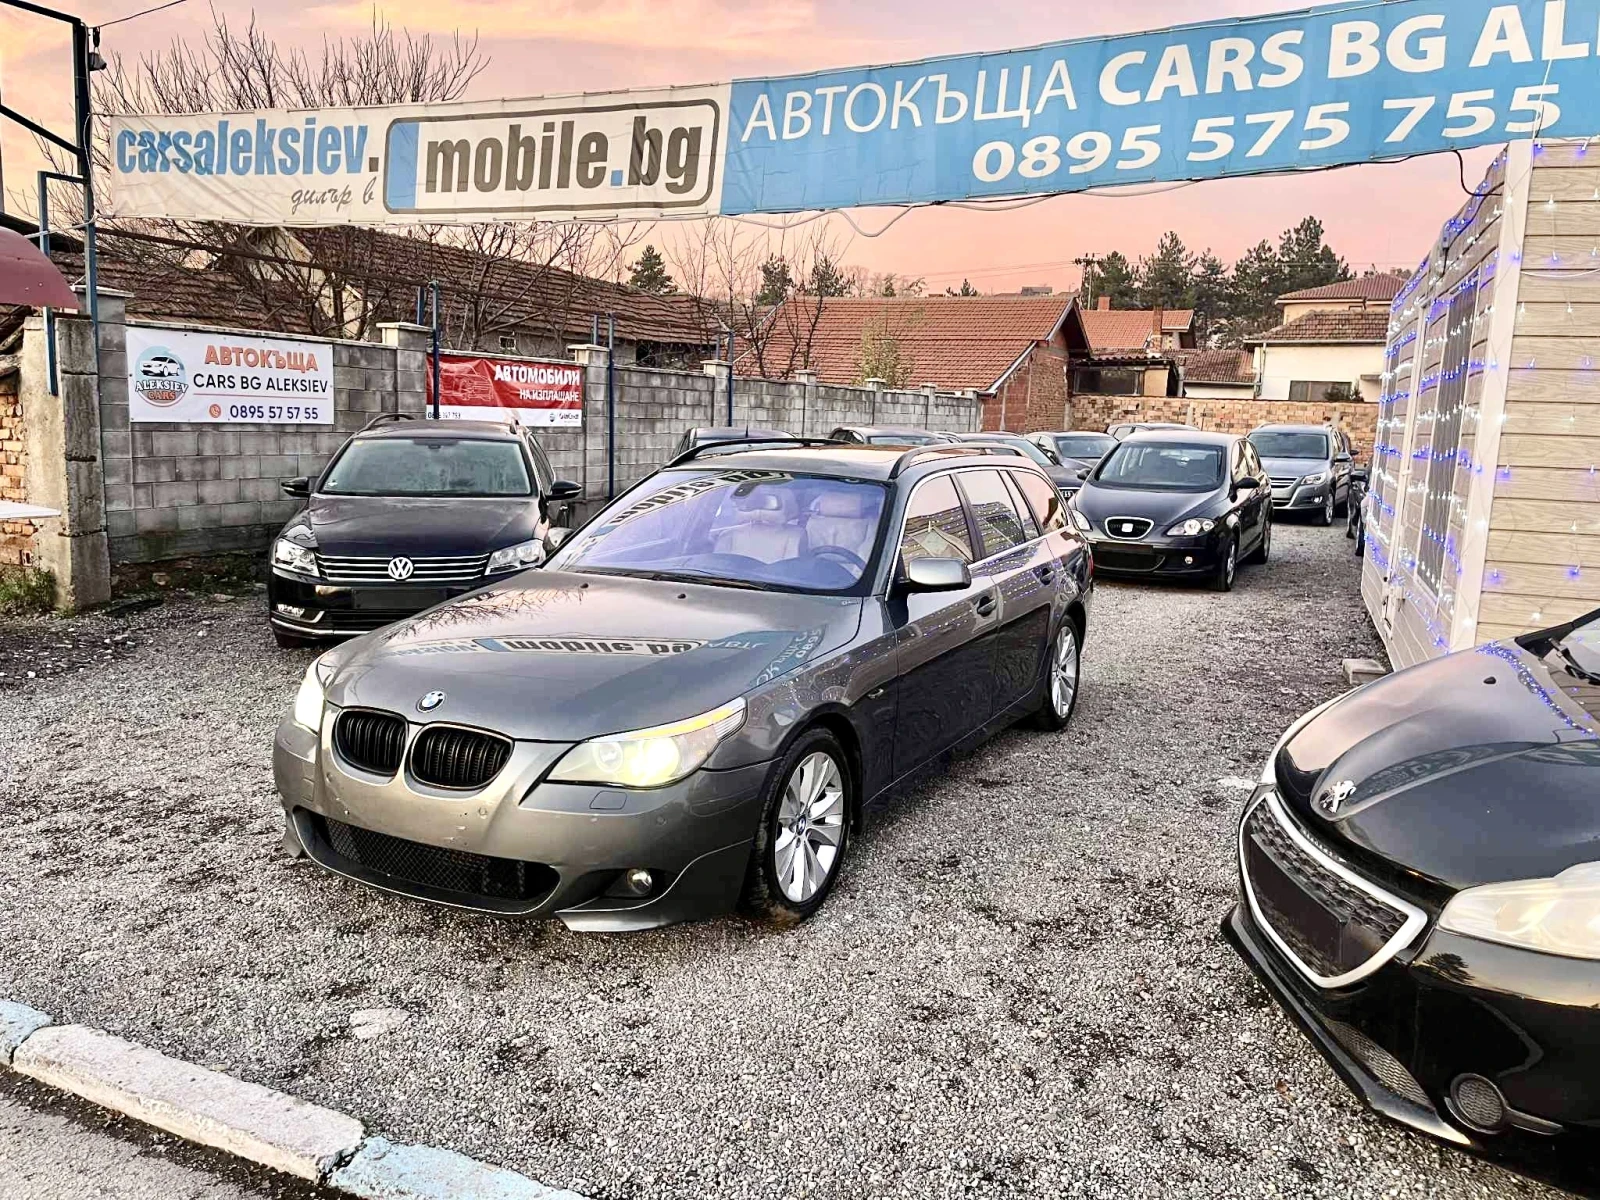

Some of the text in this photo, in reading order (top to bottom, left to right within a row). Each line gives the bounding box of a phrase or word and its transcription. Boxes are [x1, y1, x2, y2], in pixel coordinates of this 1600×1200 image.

[740, 0, 1600, 143] АВТОКЪЩА CARS BG AL
[116, 117, 379, 176] carsaleksiev.
[972, 84, 1561, 183] 0895 575 755
[425, 115, 703, 195] mobile.bg
[204, 344, 319, 374] АВТОКЪЩА
[135, 379, 189, 394] ALEKSIEV
[193, 374, 328, 393] CARS BG ALEKSIEV
[494, 364, 580, 386] АВТОМОБИЛИ
[147, 391, 176, 401] CARS
[229, 404, 319, 420] 0895 57 57 55
